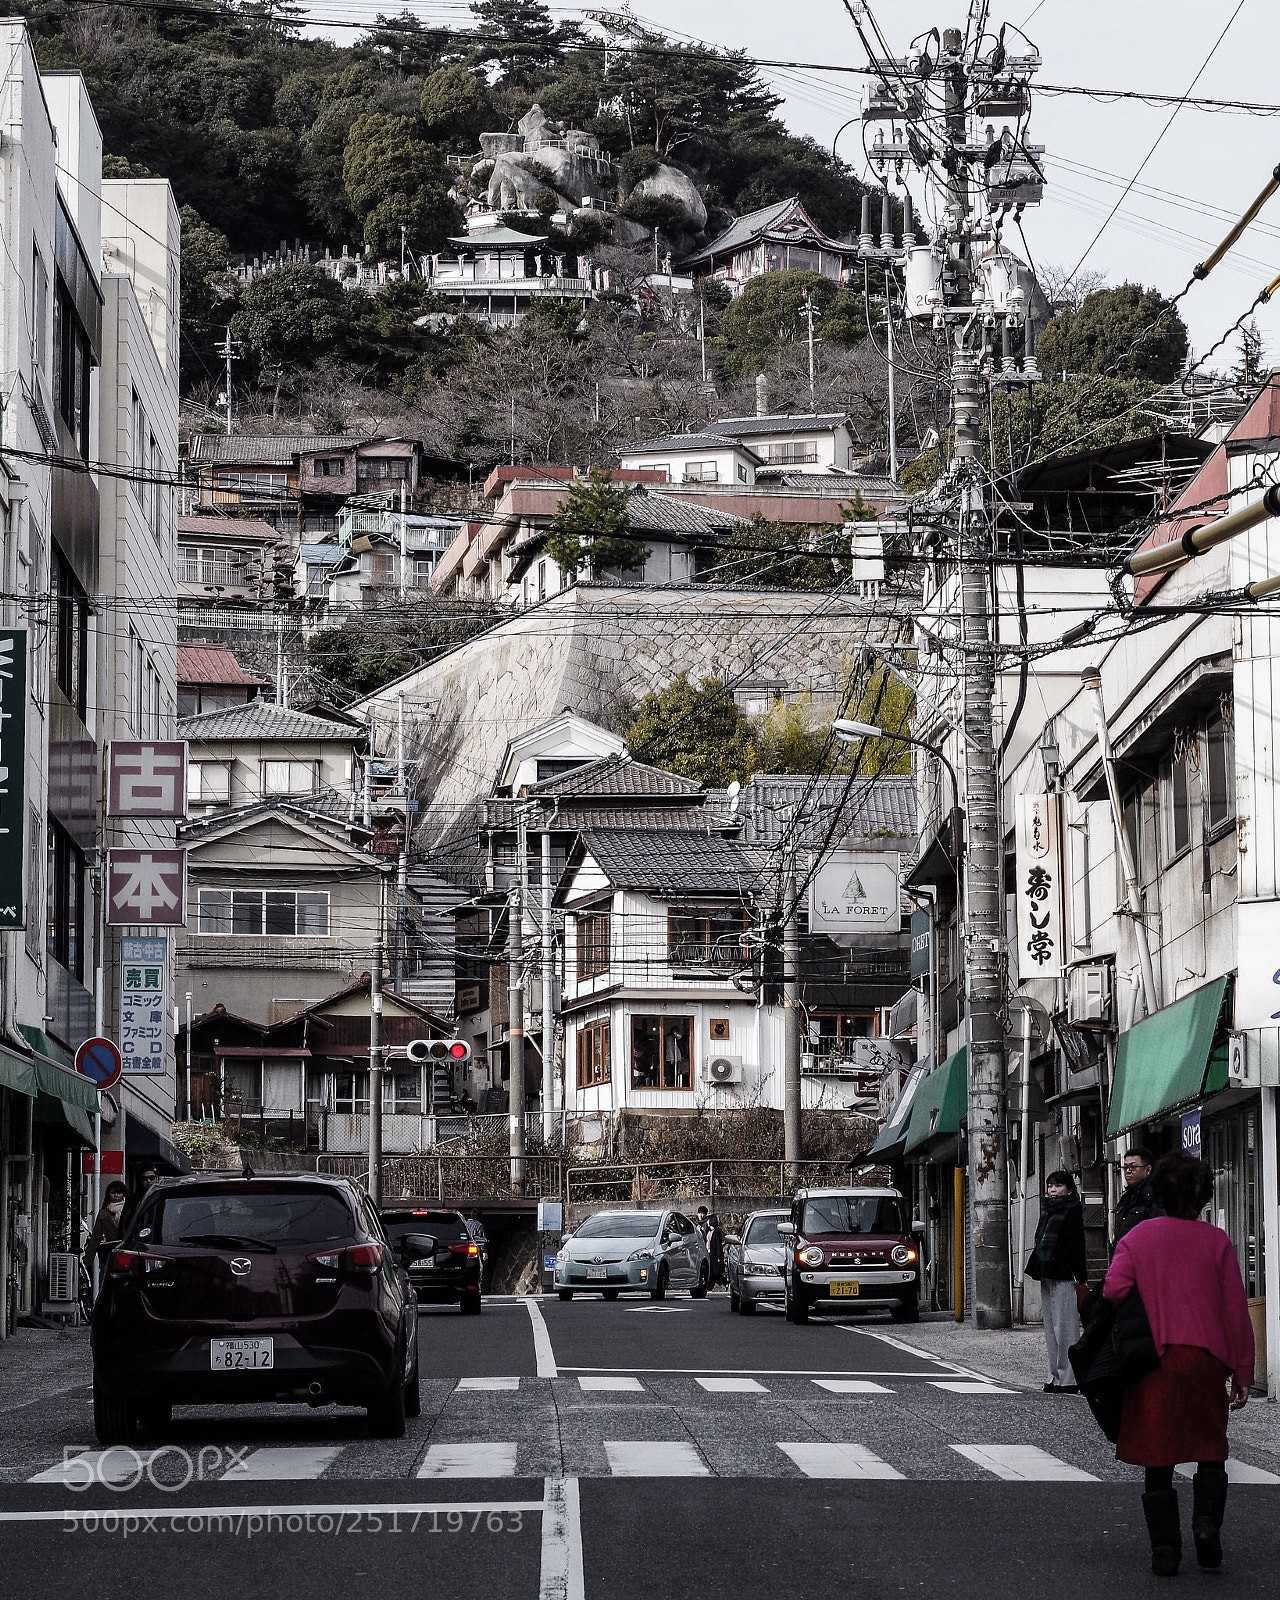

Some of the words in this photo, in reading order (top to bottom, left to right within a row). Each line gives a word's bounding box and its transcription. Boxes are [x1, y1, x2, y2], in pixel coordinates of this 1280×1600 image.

[112, 747, 181, 918] 古本
[823, 906, 840, 914] LA
[846, 906, 888, 915] FORET
[1025, 866, 1054, 966] 寿し常
[126, 968, 159, 988] 売買
[123, 995, 162, 1007] コミック
[123, 1026, 162, 1039] ファミコン
[122, 1057, 162, 1070] 古書全般
[1183, 1123, 1201, 1149] sora
[836, 1287, 858, 1295] 21-70
[224, 1350, 270, 1367] 82-12
